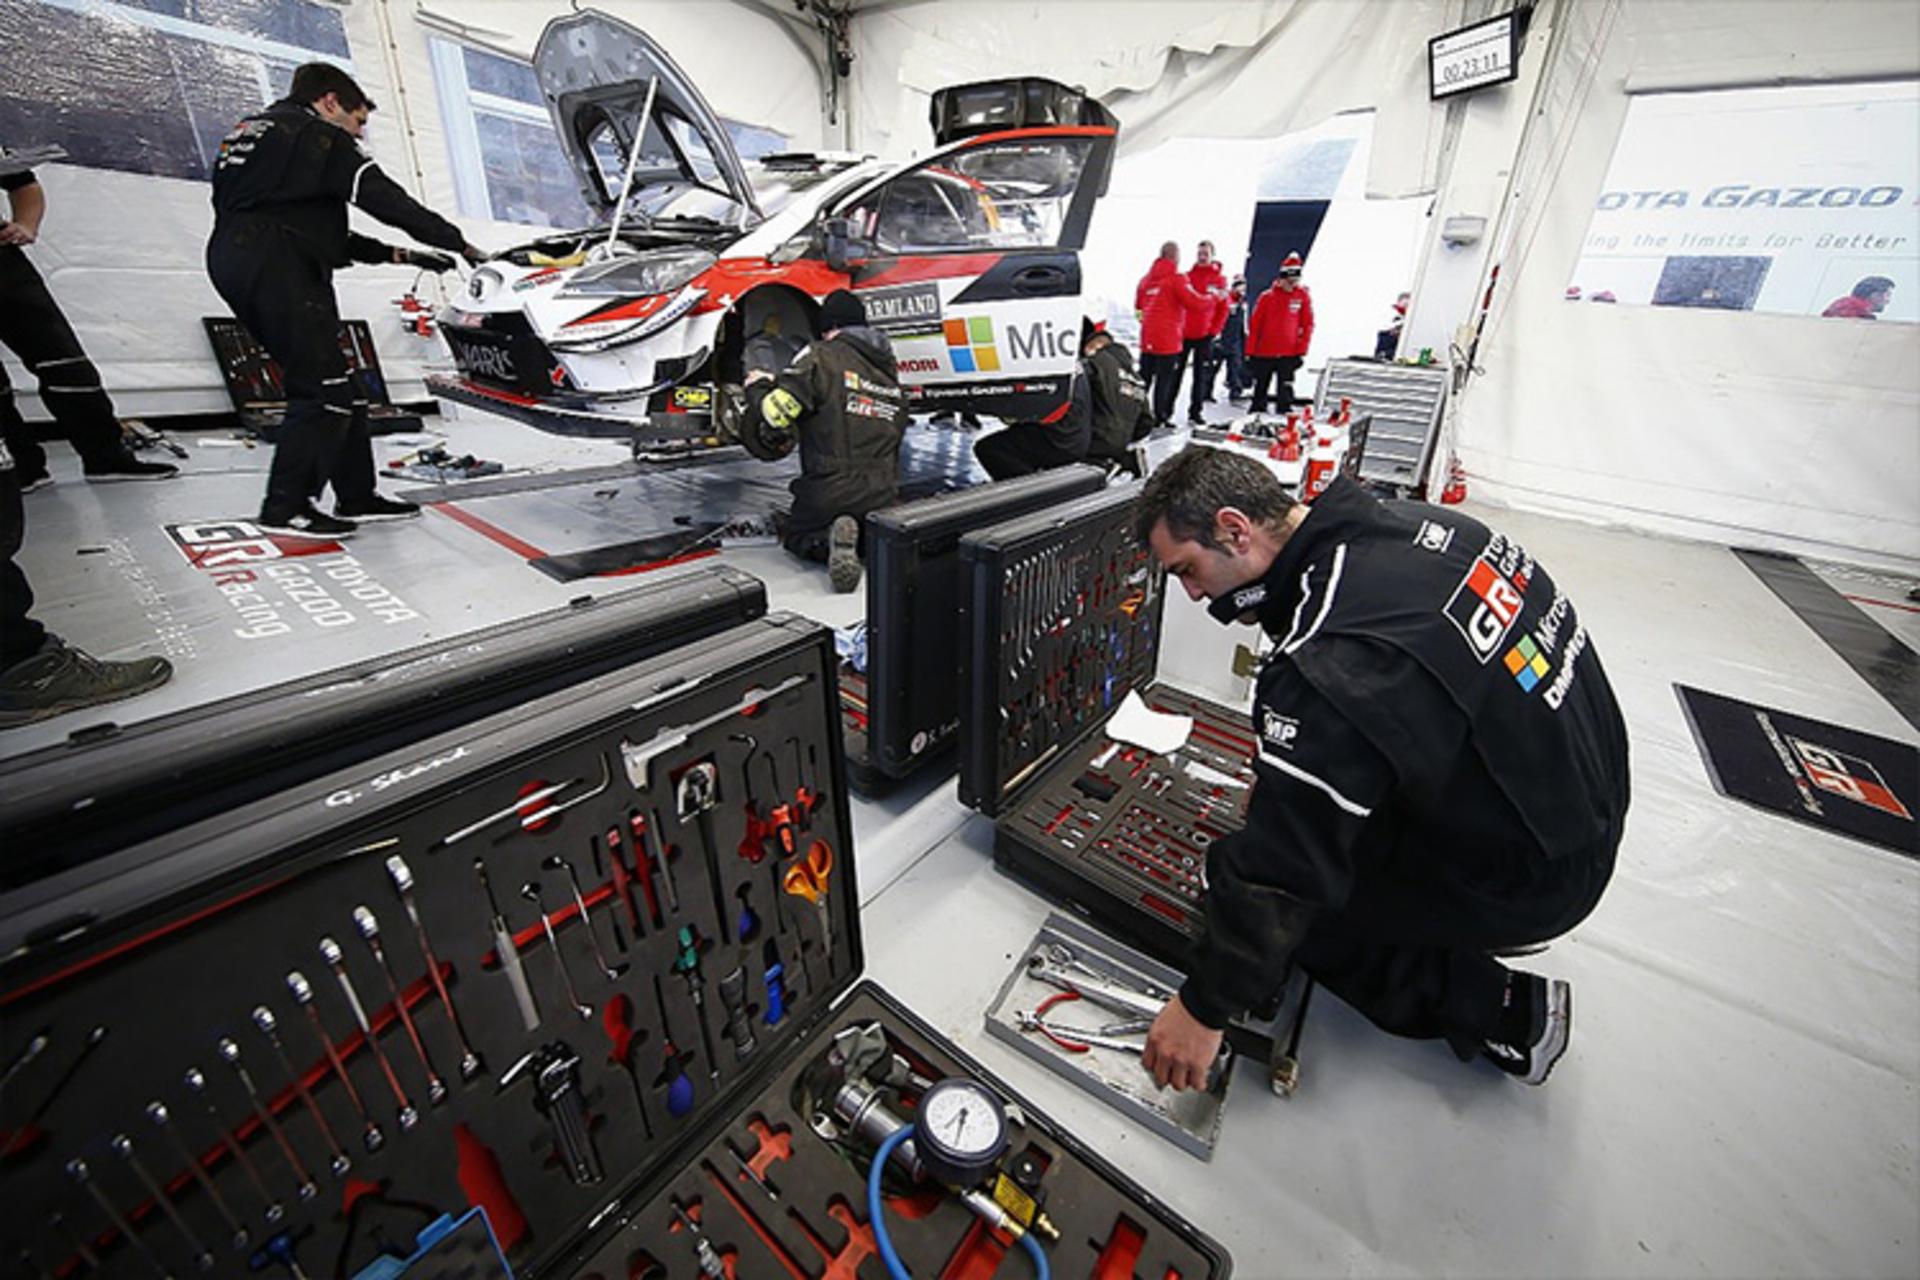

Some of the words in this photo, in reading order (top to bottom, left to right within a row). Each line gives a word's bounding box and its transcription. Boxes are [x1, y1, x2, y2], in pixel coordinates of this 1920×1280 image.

[1702, 186, 1904, 208] GAZOO
[1634, 233, 1668, 248] the
[1680, 232, 1749, 248] limits
[1763, 233, 1803, 248] for
[1816, 233, 1906, 248] Better
[1006, 321, 1076, 359] Mic
[209, 569, 292, 639] Racing
[263, 562, 357, 627] GAZOO
[318, 555, 419, 625] TOYOTA
[1468, 577, 1524, 653] GR
